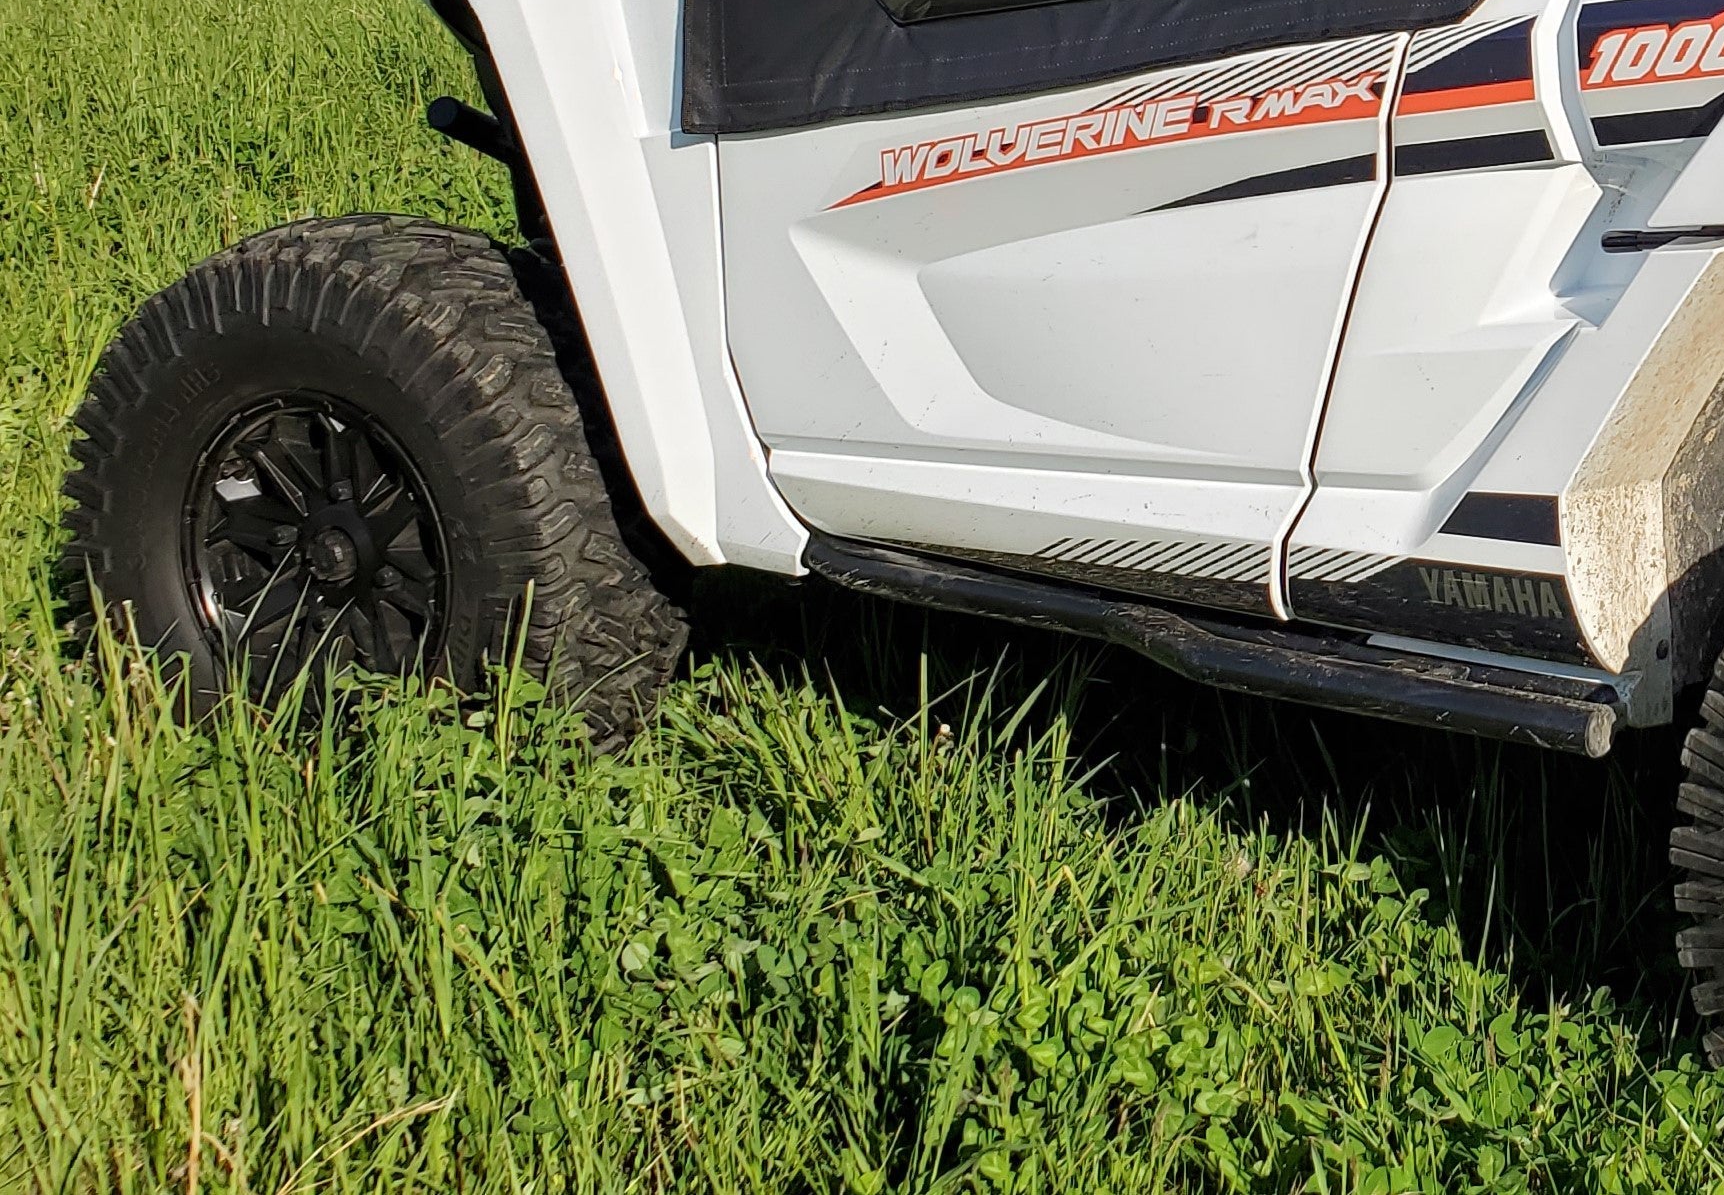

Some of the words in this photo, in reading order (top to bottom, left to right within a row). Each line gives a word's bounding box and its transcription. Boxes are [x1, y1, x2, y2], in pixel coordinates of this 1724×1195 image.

[880, 94, 1199, 187] WOLVERINE
[1208, 71, 1382, 131] RMAX
[1418, 565, 1564, 619] YAMAHA
